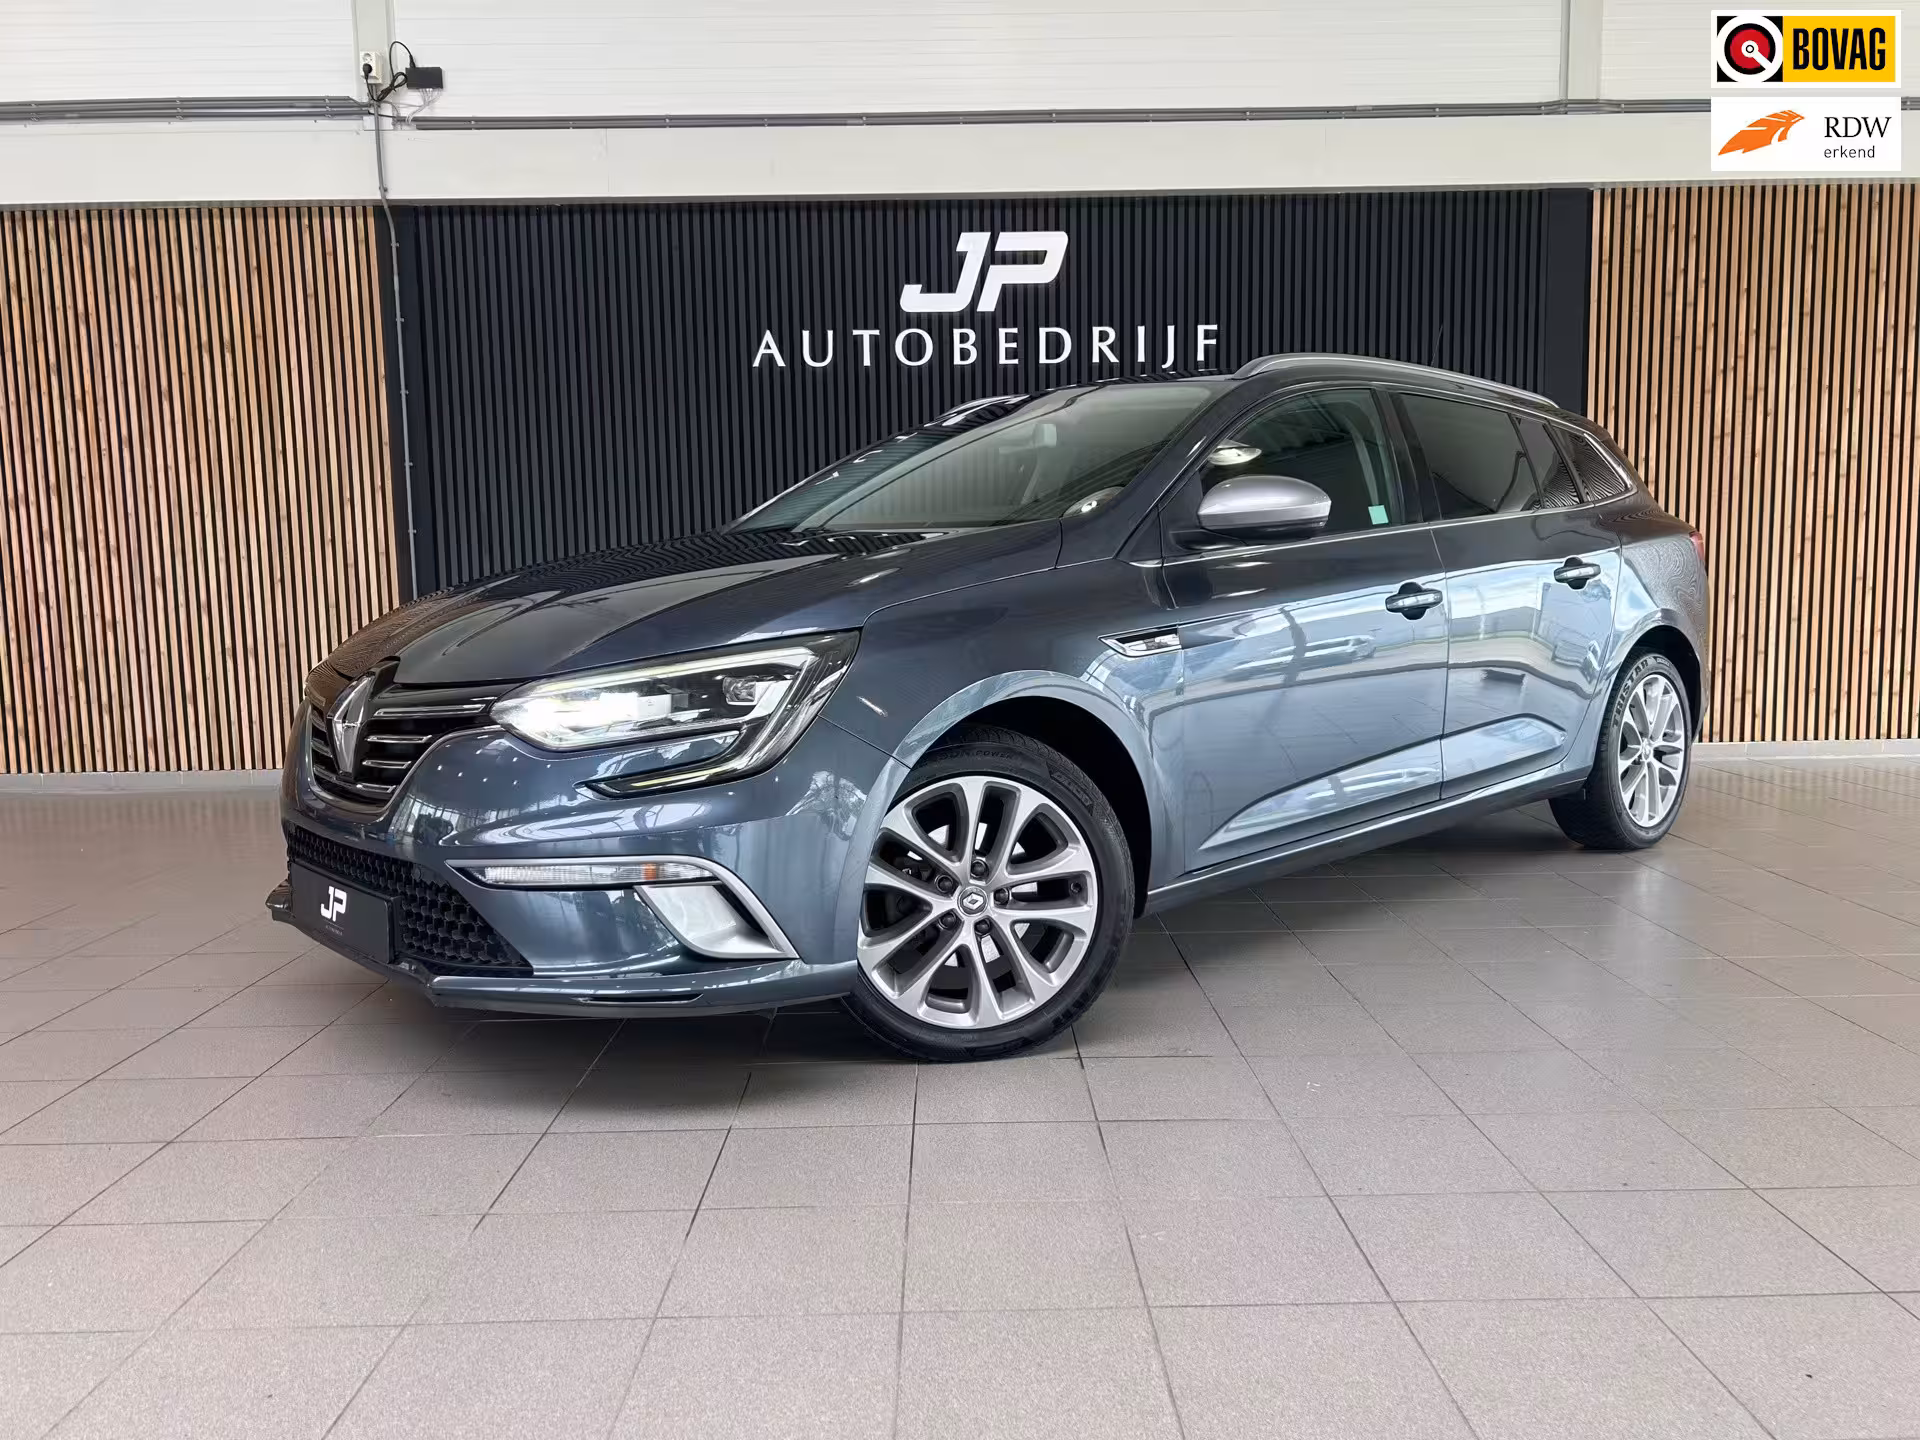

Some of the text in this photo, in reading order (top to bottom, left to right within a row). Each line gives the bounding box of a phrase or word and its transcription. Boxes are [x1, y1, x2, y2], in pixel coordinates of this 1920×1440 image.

[899, 230, 1069, 313] JP
[752, 324, 1218, 369] AUTOBEDRIJF
[1612, 659, 1648, 728] TRISTAR
[320, 885, 347, 922] JP
